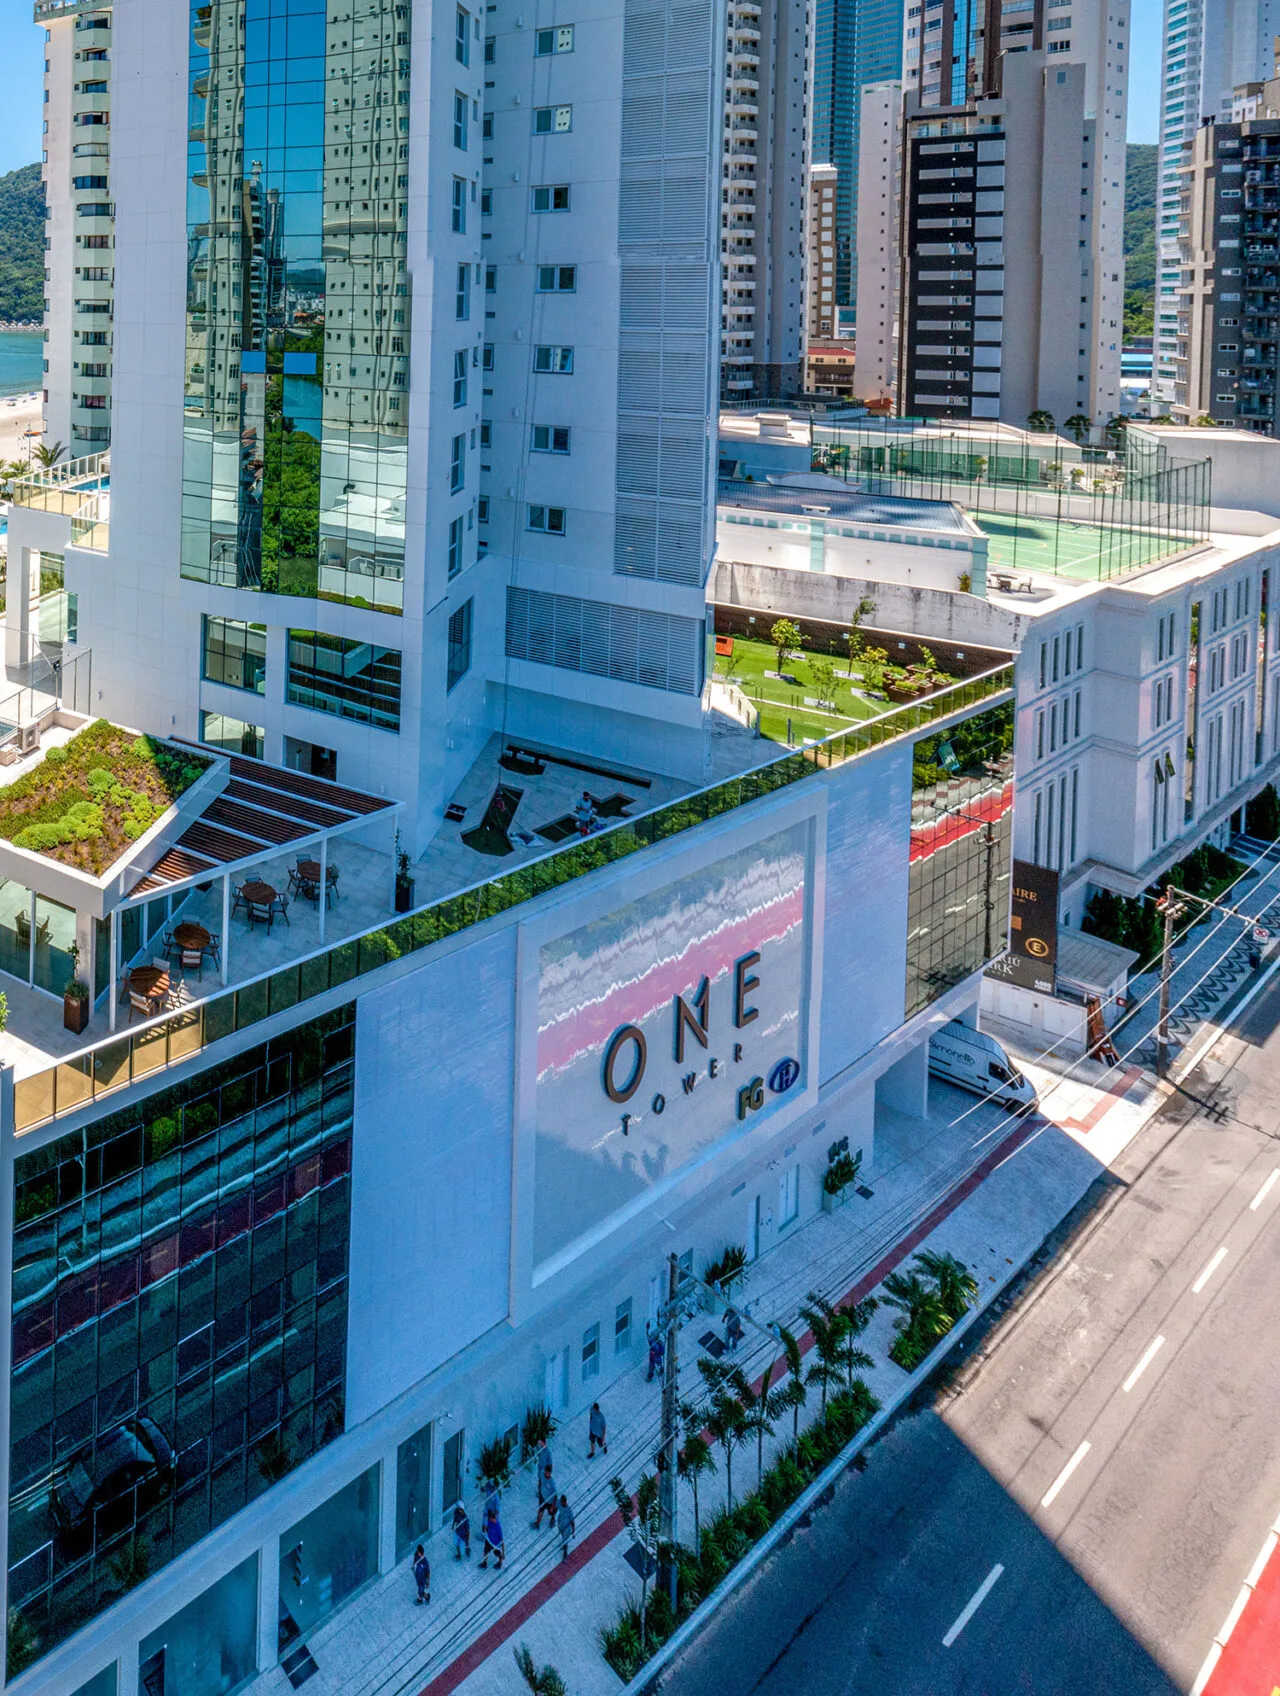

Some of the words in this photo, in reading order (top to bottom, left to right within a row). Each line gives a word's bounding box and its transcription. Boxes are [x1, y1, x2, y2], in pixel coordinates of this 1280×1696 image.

[602, 949, 761, 1104] ONE
[620, 1042, 743, 1137] TOWER
[738, 1075, 764, 1121] FG
